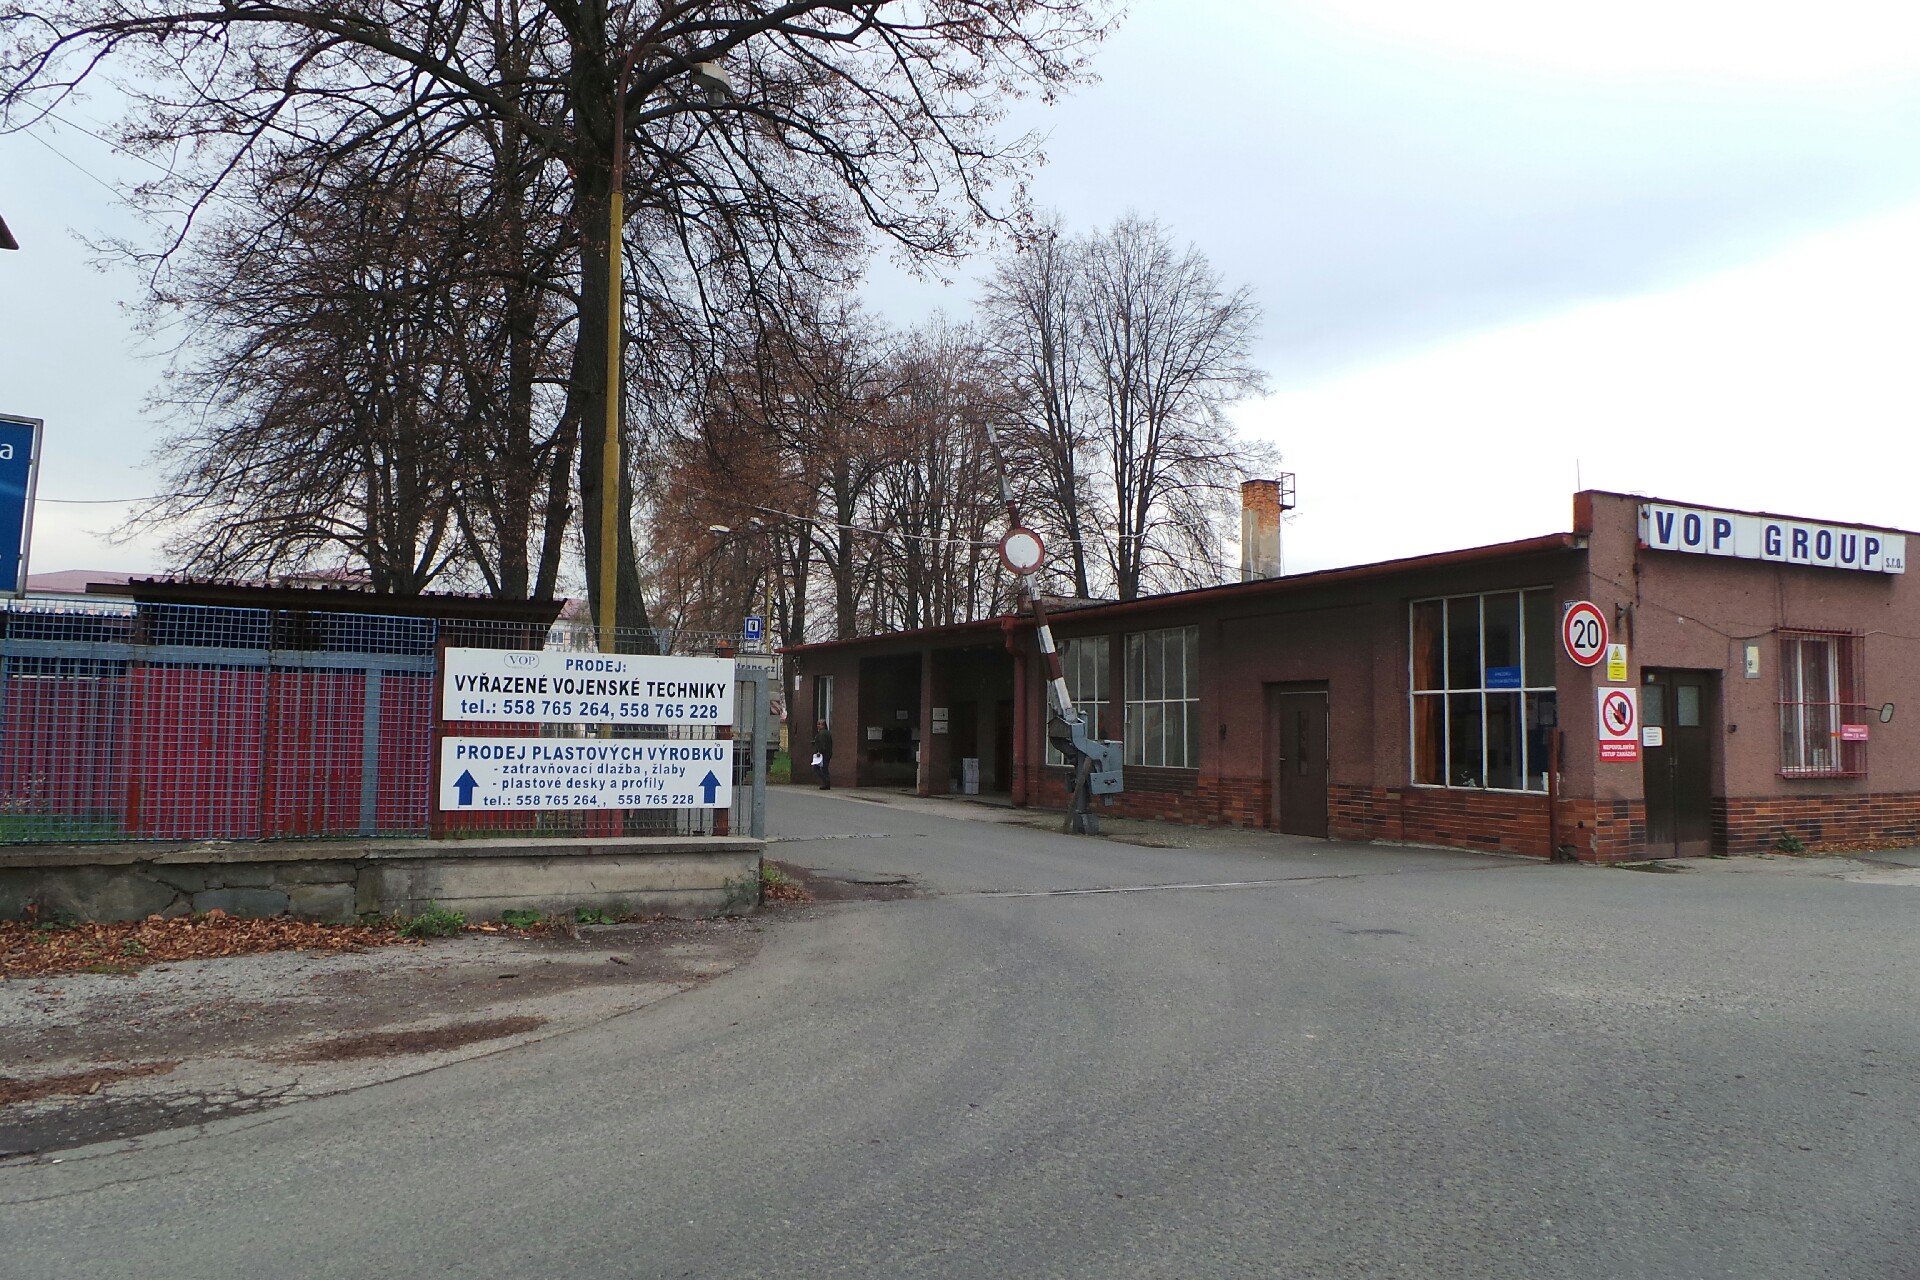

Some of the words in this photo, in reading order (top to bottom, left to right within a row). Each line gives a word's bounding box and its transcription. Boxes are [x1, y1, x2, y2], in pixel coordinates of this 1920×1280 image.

[1654, 510, 1732, 550] VOP
[1764, 524, 1881, 566] GROUP
[1884, 557, 1904, 570] s.r.o.
[1573, 619, 1599, 649] 20
[510, 654, 537, 665] VOP
[566, 656, 626, 672] PRODEJ:
[455, 673, 547, 693] VYŘAZENÉ
[553, 678, 639, 696] VOJENSKÉ
[647, 682, 726, 698] TECHNIKY
[461, 699, 495, 713] tel.:
[503, 700, 534, 714] 558
[542, 701, 571, 715] 765
[620, 703, 649, 717] 558
[656, 704, 683, 718] 765
[690, 705, 717, 718] 228
[457, 745, 525, 760] PRODEJ
[533, 744, 642, 760] PLASTOVÝCH
[648, 743, 723, 760] VÝROBKŮ
[503, 763, 592, 773] zatravňovací
[651, 764, 685, 779] žlaby
[502, 777, 561, 791] plastové
[567, 778, 605, 791] desky
[610, 780, 616, 788] a
[622, 777, 664, 790] profily
[484, 796, 510, 805] tel.:
[516, 795, 540, 805] 558
[545, 795, 568, 805] 765
[618, 795, 640, 804] 558
[646, 795, 667, 804] 765
[672, 795, 693, 804] 228
